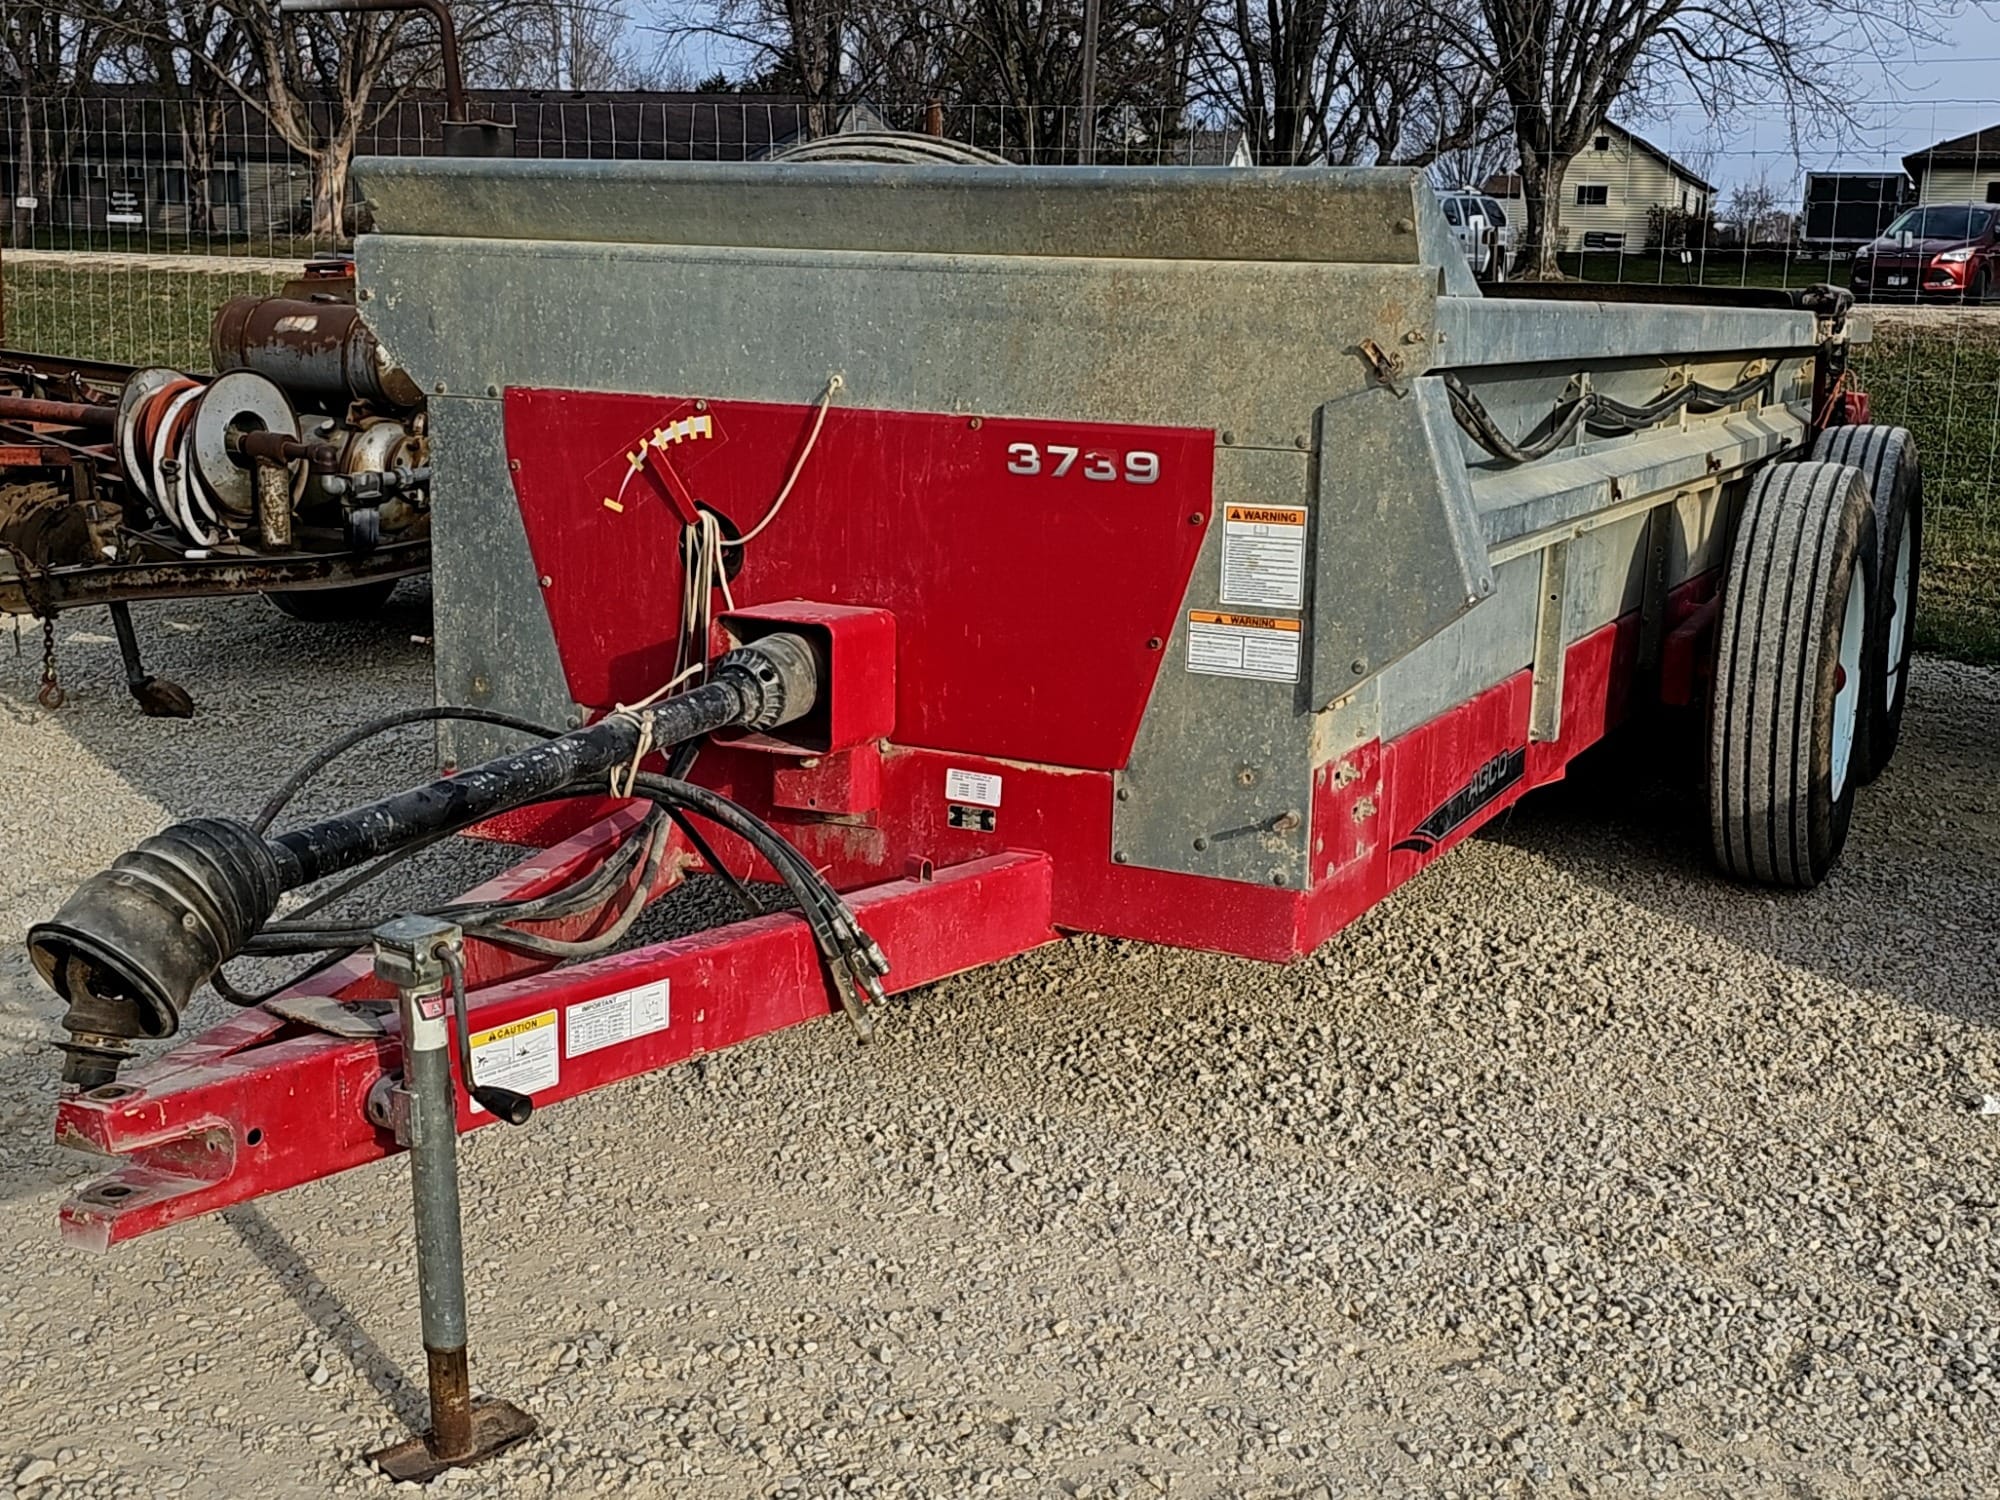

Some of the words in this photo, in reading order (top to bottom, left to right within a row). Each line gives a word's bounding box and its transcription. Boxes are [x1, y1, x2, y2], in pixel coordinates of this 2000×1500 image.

[1007, 442, 1161, 485] 3739
[1243, 509, 1297, 523] WARNING
[1230, 615, 1276, 628] WARNING
[1467, 750, 1508, 803] AGCO
[581, 996, 618, 1013] IMPORTANT
[497, 1019, 538, 1039] CAUTION
